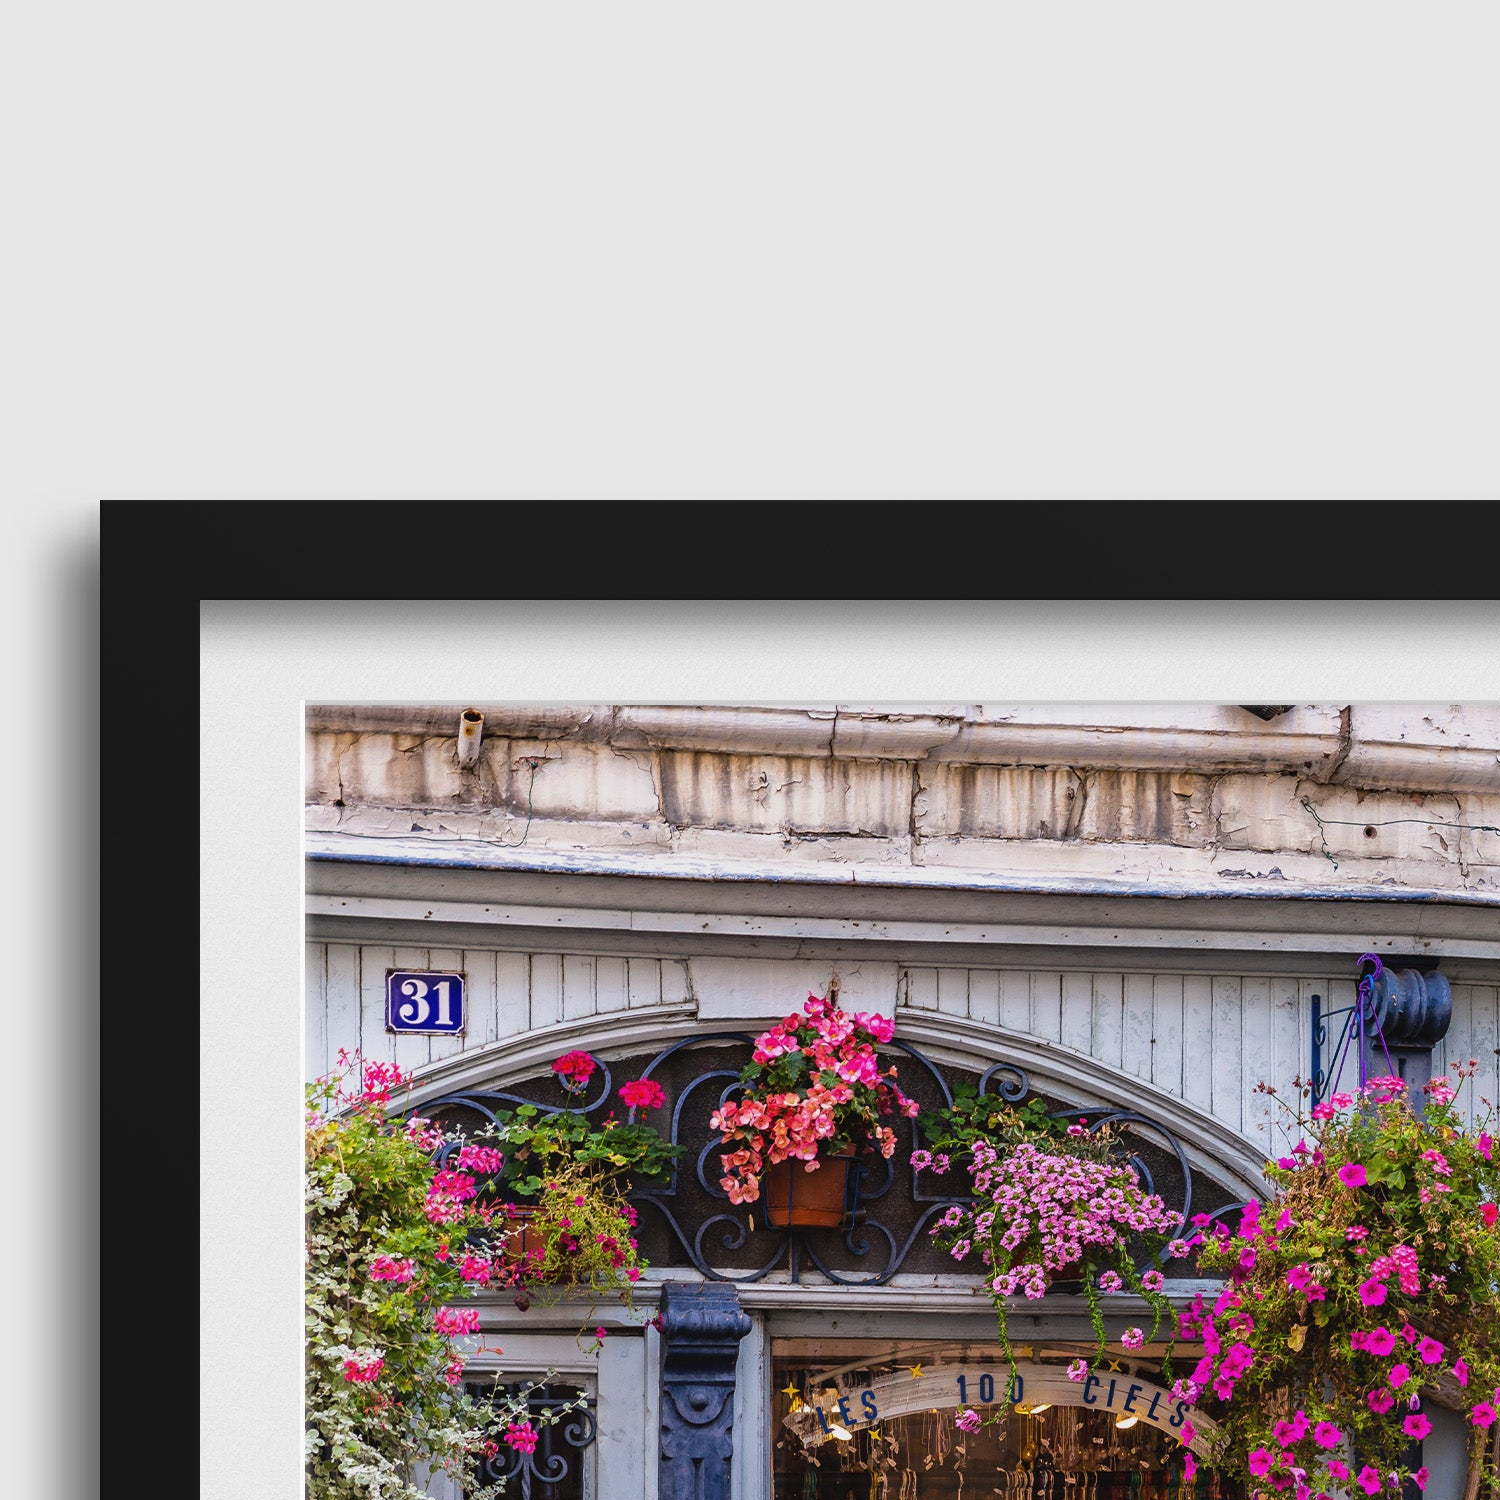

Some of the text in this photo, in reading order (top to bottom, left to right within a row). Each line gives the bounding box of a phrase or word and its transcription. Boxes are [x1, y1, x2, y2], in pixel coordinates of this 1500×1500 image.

[399, 979, 454, 1026] 31
[815, 1373, 1190, 1434] LES 100 CIELS
